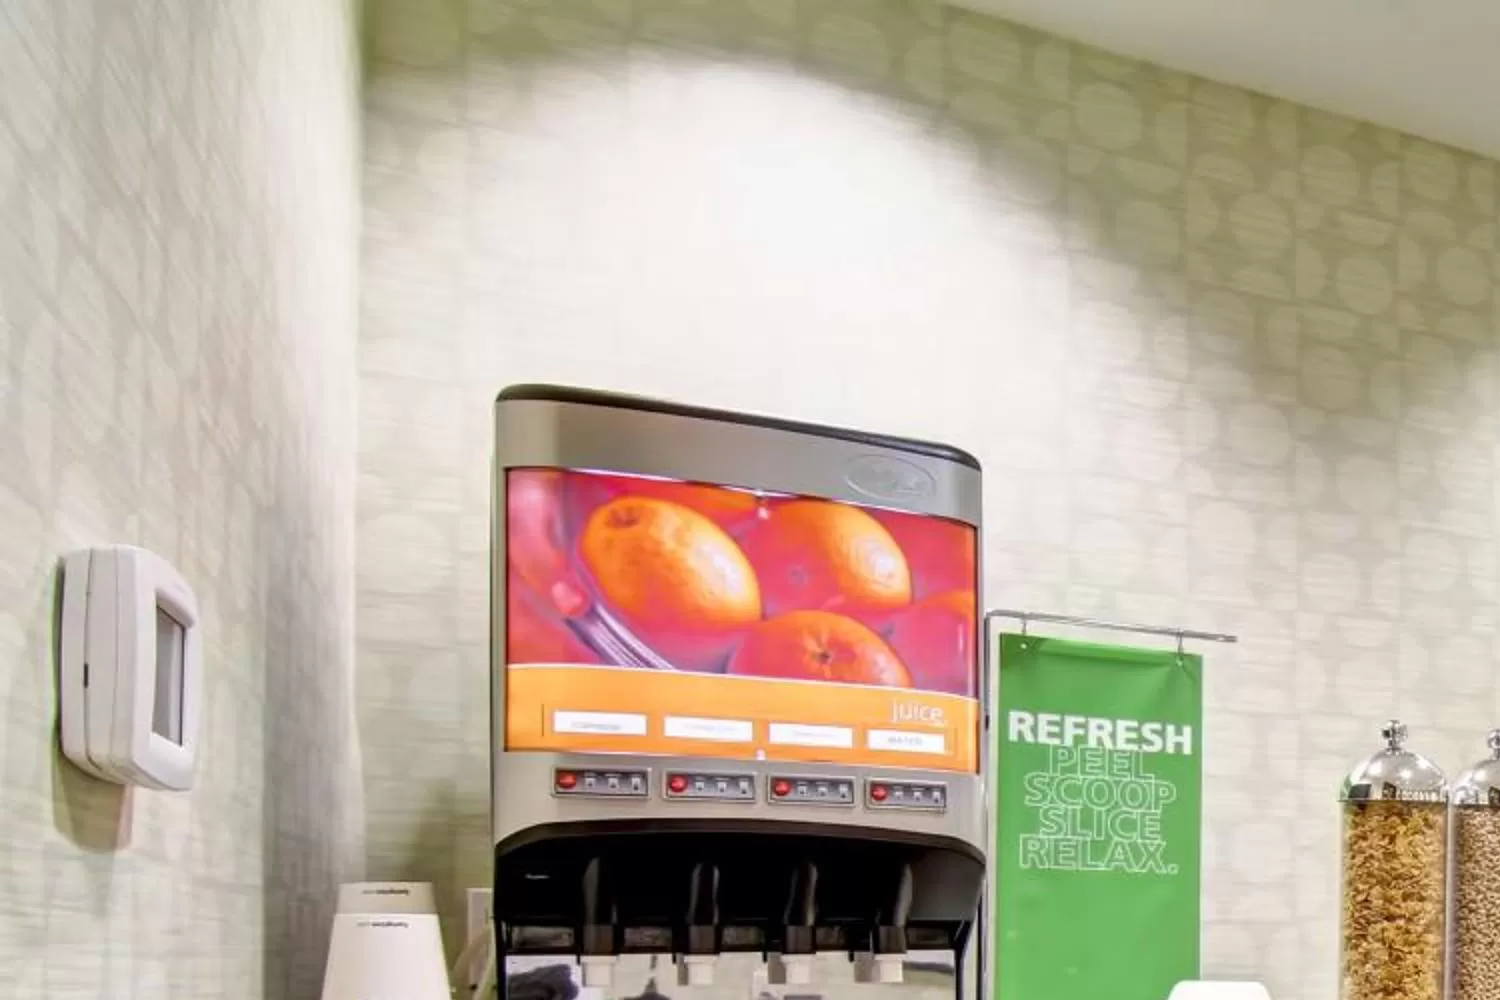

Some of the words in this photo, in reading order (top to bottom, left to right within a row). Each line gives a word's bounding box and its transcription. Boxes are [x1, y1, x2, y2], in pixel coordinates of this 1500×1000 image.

[1008, 710, 1193, 755] REFRESH
[1050, 744, 1155, 783] PEEL
[1024, 772, 1177, 812] SCOOP
[1039, 804, 1162, 842] SLICE
[1019, 834, 1178, 874] RELAX.
